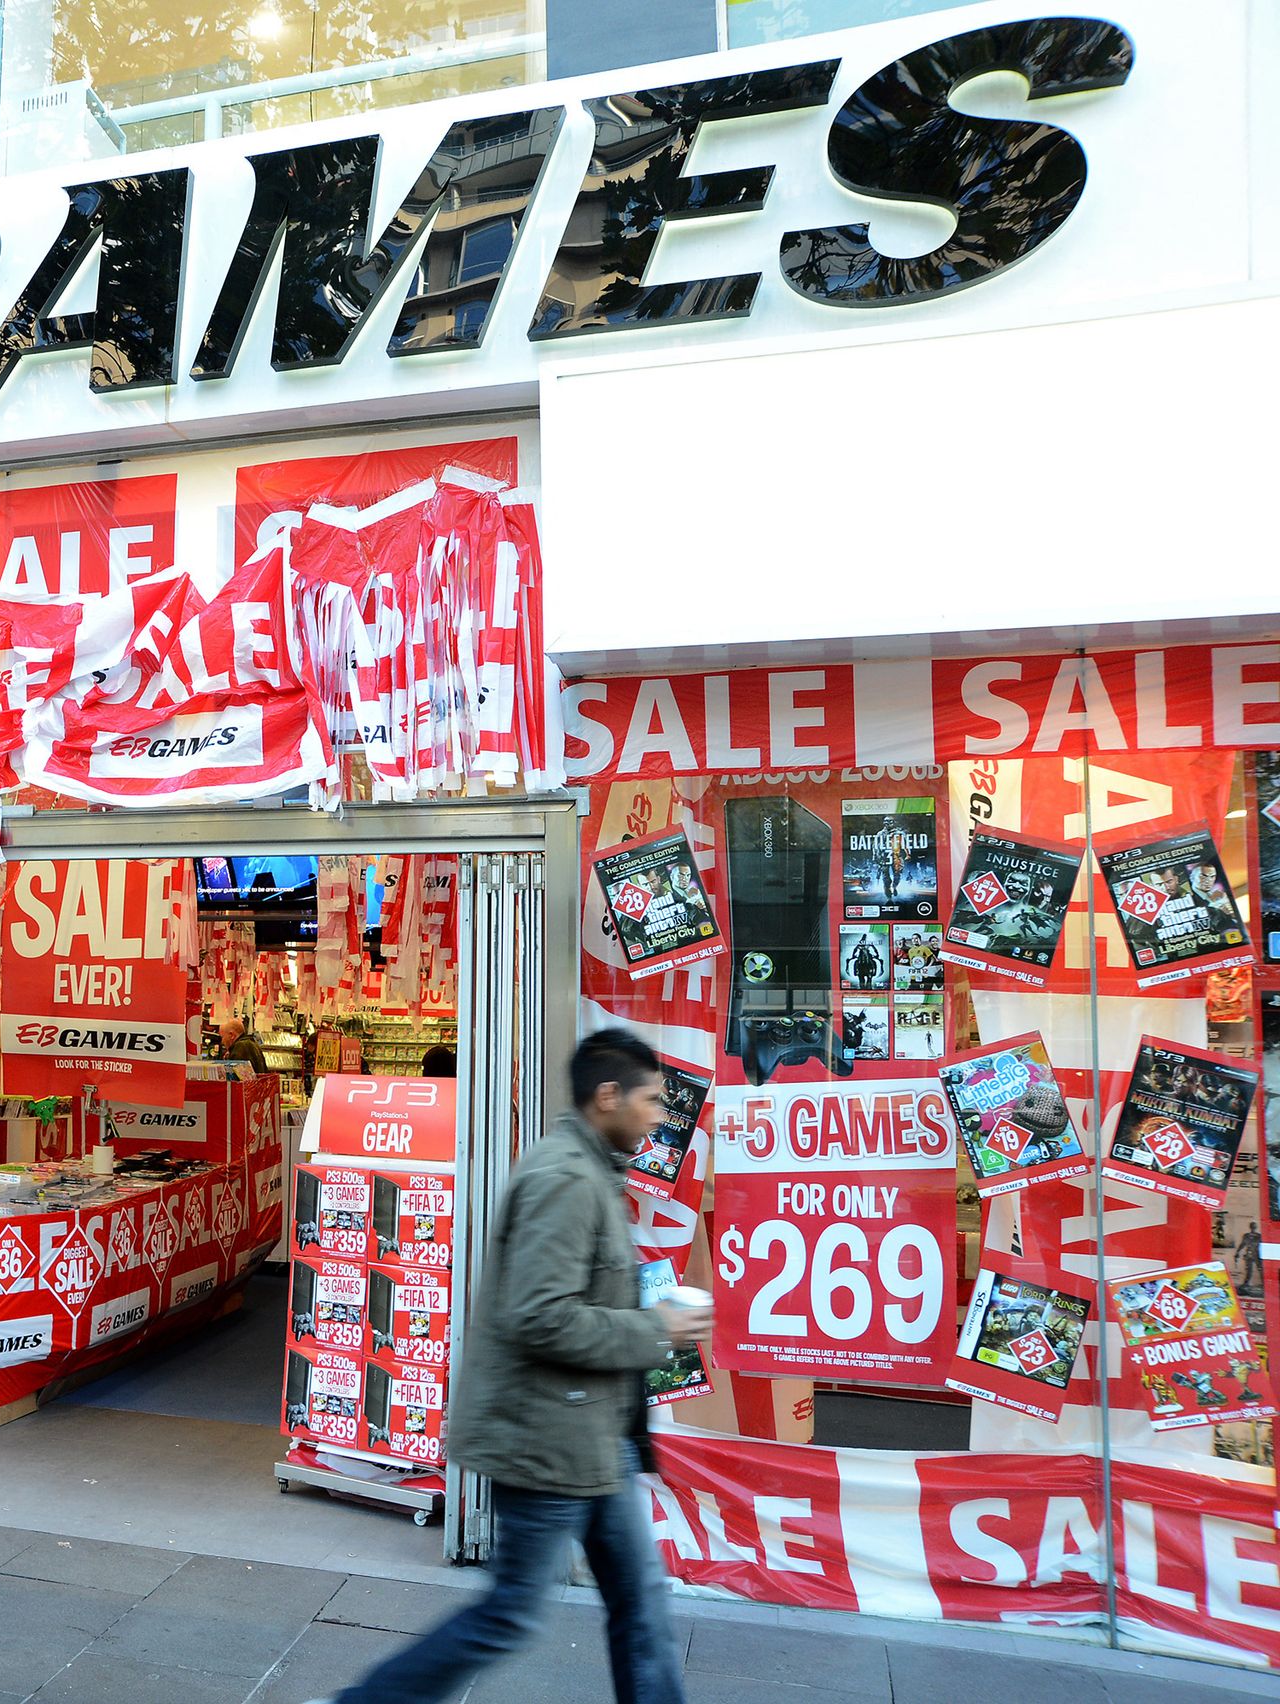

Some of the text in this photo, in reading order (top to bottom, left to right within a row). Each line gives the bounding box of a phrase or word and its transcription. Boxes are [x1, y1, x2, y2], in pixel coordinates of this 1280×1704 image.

[961, 642, 1280, 755] SALE
[562, 670, 829, 778] SALE
[109, 725, 238, 761] EB GAMES
[850, 833, 928, 851] BATTLEFIELD
[987, 835, 1016, 850] PS3
[605, 865, 618, 877] THE
[618, 854, 653, 873] COMPLETE
[653, 845, 680, 862] EDITION
[607, 852, 630, 867] PS3
[884, 850, 893, 865] 3
[985, 852, 1060, 879] INJUSTICE
[1112, 843, 1204, 874] THE COMPLETE EDITION
[1113, 849, 1142, 863] PS3
[618, 893, 645, 914] $28
[972, 882, 999, 906] $57
[1127, 891, 1158, 914] $28
[10, 860, 177, 960] SALE
[646, 928, 696, 951] Liberty City
[1158, 932, 1221, 957] Liberty City
[699, 946, 715, 959] SALE
[53, 963, 133, 1008] EVER!
[897, 1010, 941, 1027] RAGE
[16, 1022, 166, 1053] EB GAMES
[55, 1059, 133, 1074] LOOK FOR THE STICKER
[1154, 1051, 1184, 1064] PS3
[348, 1081, 438, 1107] PS3
[977, 1082, 1027, 1113] Planet
[114, 1110, 197, 1127] EB GAMES
[719, 1094, 949, 1159] +5 GAMES
[1184, 1106, 1238, 1131] KOMBAT
[362, 1122, 413, 1153] GEAR
[994, 1130, 1019, 1152] $19
[1154, 1133, 1184, 1160] $28
[325, 1170, 342, 1182] PS3
[410, 1176, 426, 1188] PS3
[323, 1187, 365, 1201] +3 GAMES
[403, 1194, 445, 1212] +FIFA 12
[777, 1182, 899, 1219] FOR ONLY
[1, 1239, 16, 1248] ONLY
[63, 1245, 88, 1259] BIGGEST
[114, 1227, 131, 1259] $36
[150, 1230, 172, 1262] SALE
[321, 1240, 334, 1248] ONLY
[334, 1231, 367, 1253] $359
[402, 1243, 414, 1251] FOR
[400, 1250, 414, 1260] ONLY
[414, 1243, 449, 1265] $299
[54, 1254, 93, 1293] SALE
[718, 1219, 944, 1345] $269
[187, 1276, 215, 1298] GAMES
[319, 1279, 361, 1295] +3 GAMES
[397, 1289, 440, 1308] +FIFA 12
[67, 1294, 85, 1305] EVER!
[1001, 1282, 1018, 1294] LEGO
[1053, 1296, 1086, 1318] RINGS
[1154, 1297, 1188, 1320] $68
[97, 1306, 145, 1334] EB GAMES
[329, 1322, 363, 1346] $359
[409, 1338, 445, 1362] $299
[800, 1348, 821, 1356] STOCKS
[904, 1354, 914, 1362] ANY
[1019, 1338, 1047, 1366] $23
[1143, 1339, 1202, 1366] BONUS
[1202, 1331, 1252, 1357] GIANT
[648, 1487, 825, 1577] ALE
[948, 1496, 1280, 1633] SALE
